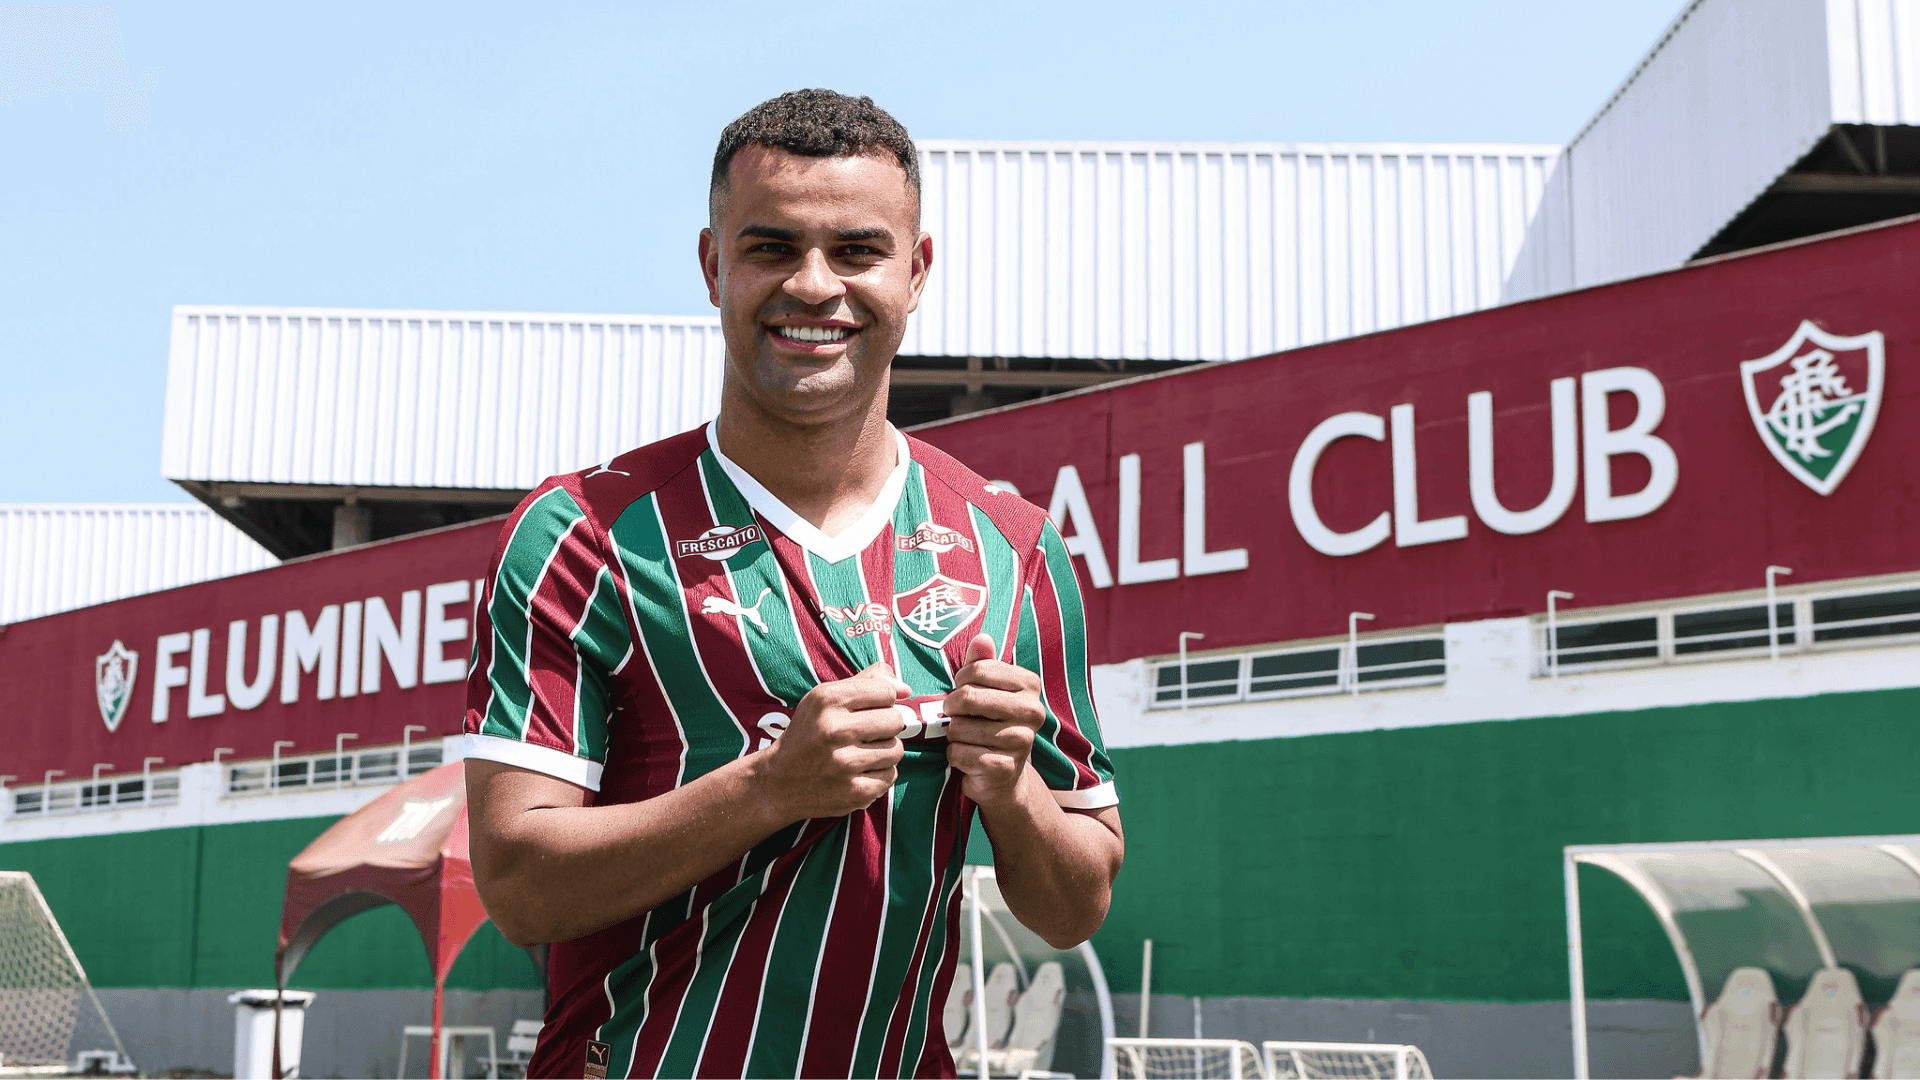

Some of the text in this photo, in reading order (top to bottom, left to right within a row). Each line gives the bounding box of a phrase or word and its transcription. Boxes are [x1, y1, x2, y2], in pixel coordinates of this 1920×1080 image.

[151, 579, 484, 723] FLUMINE
[989, 440, 1248, 589] ALL
[1289, 366, 1679, 556] CLUB
[681, 527, 757, 554] FRESCATTO
[900, 530, 970, 550] FRESCATTO
